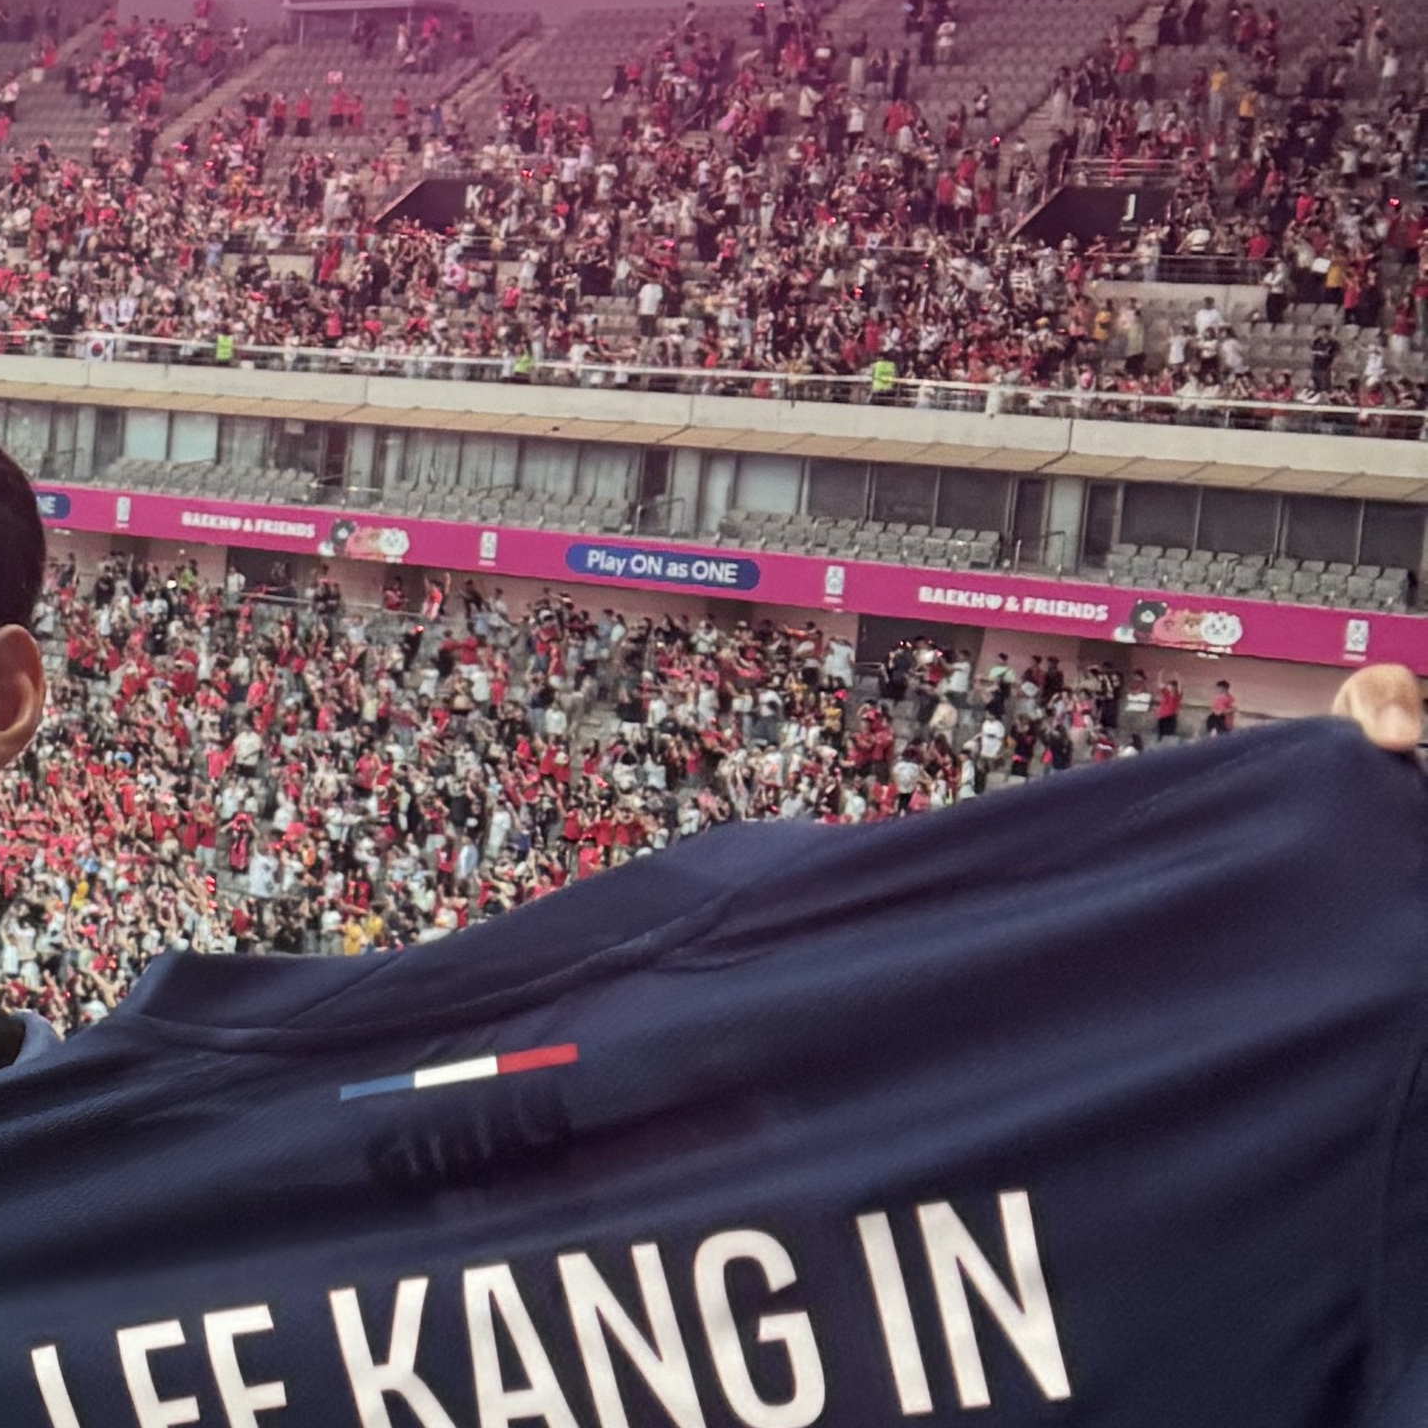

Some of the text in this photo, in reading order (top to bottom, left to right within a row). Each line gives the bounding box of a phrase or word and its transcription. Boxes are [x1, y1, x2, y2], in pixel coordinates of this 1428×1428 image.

[465, 184, 483, 209] K
[1121, 193, 1137, 222] J
[255, 518, 316, 538] FRIENDS
[587, 549, 740, 584] Play ON as ONE
[1005, 595, 1020, 613] &
[1022, 597, 1109, 622] FRIENDS
[856, 1189, 1073, 1416] IN
